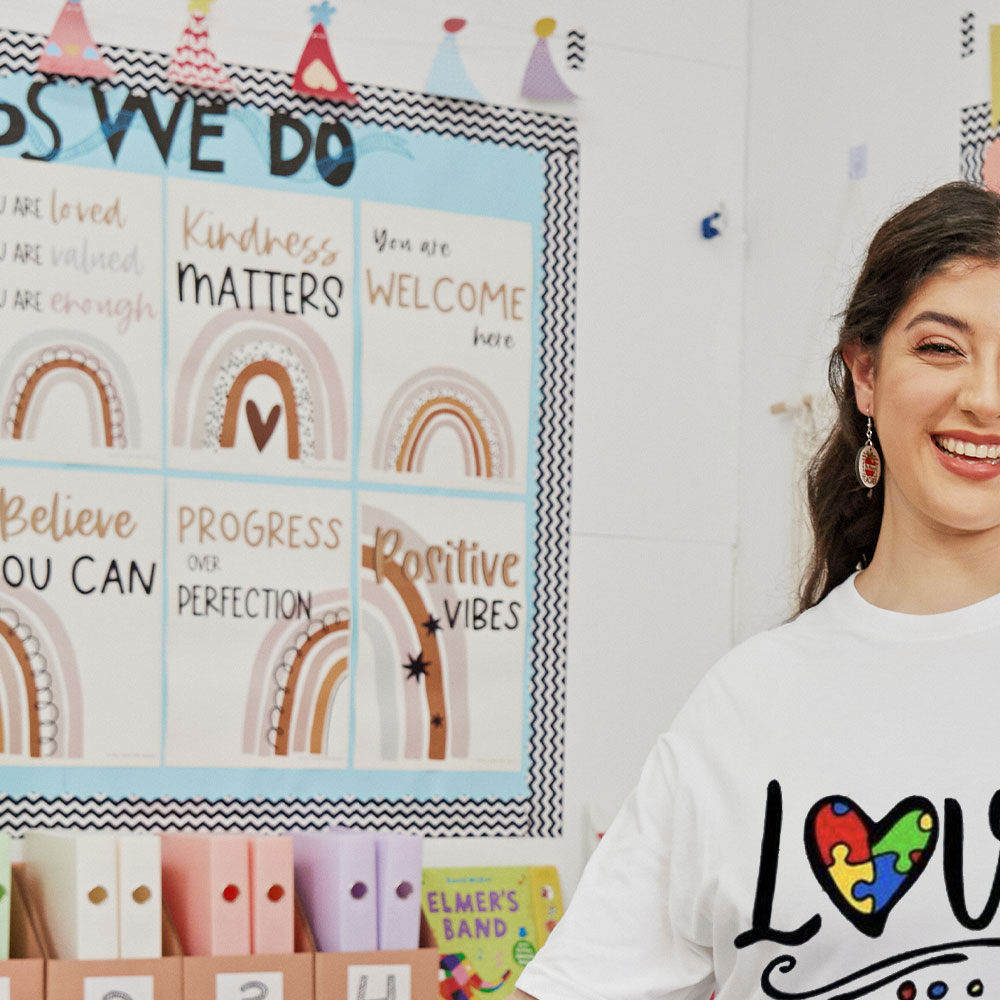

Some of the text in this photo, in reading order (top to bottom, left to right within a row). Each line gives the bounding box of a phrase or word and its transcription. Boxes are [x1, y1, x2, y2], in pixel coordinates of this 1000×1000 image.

[91, 84, 229, 172] WE
[270, 113, 356, 187] DO
[14, 197, 43, 219] ARE
[50, 187, 126, 229] loved
[182, 204, 338, 267] Kindness
[373, 227, 452, 256] You are
[14, 243, 43, 266] ARE
[50, 238, 143, 276] valued
[177, 261, 343, 319] MATTERS
[366, 267, 526, 321] WELCOME
[13, 289, 43, 314] ARE
[49, 290, 156, 335] enough
[473, 326, 516, 350] here
[179, 505, 343, 550] PROGRESS
[2, 555, 156, 595] OU CAN
[187, 554, 221, 572] OVER
[374, 525, 520, 588] Positive
[178, 584, 312, 620] PERFECTION
[444, 597, 522, 631] VIBES
[427, 889, 519, 914] ELMER'S
[443, 917, 507, 941] BAND
